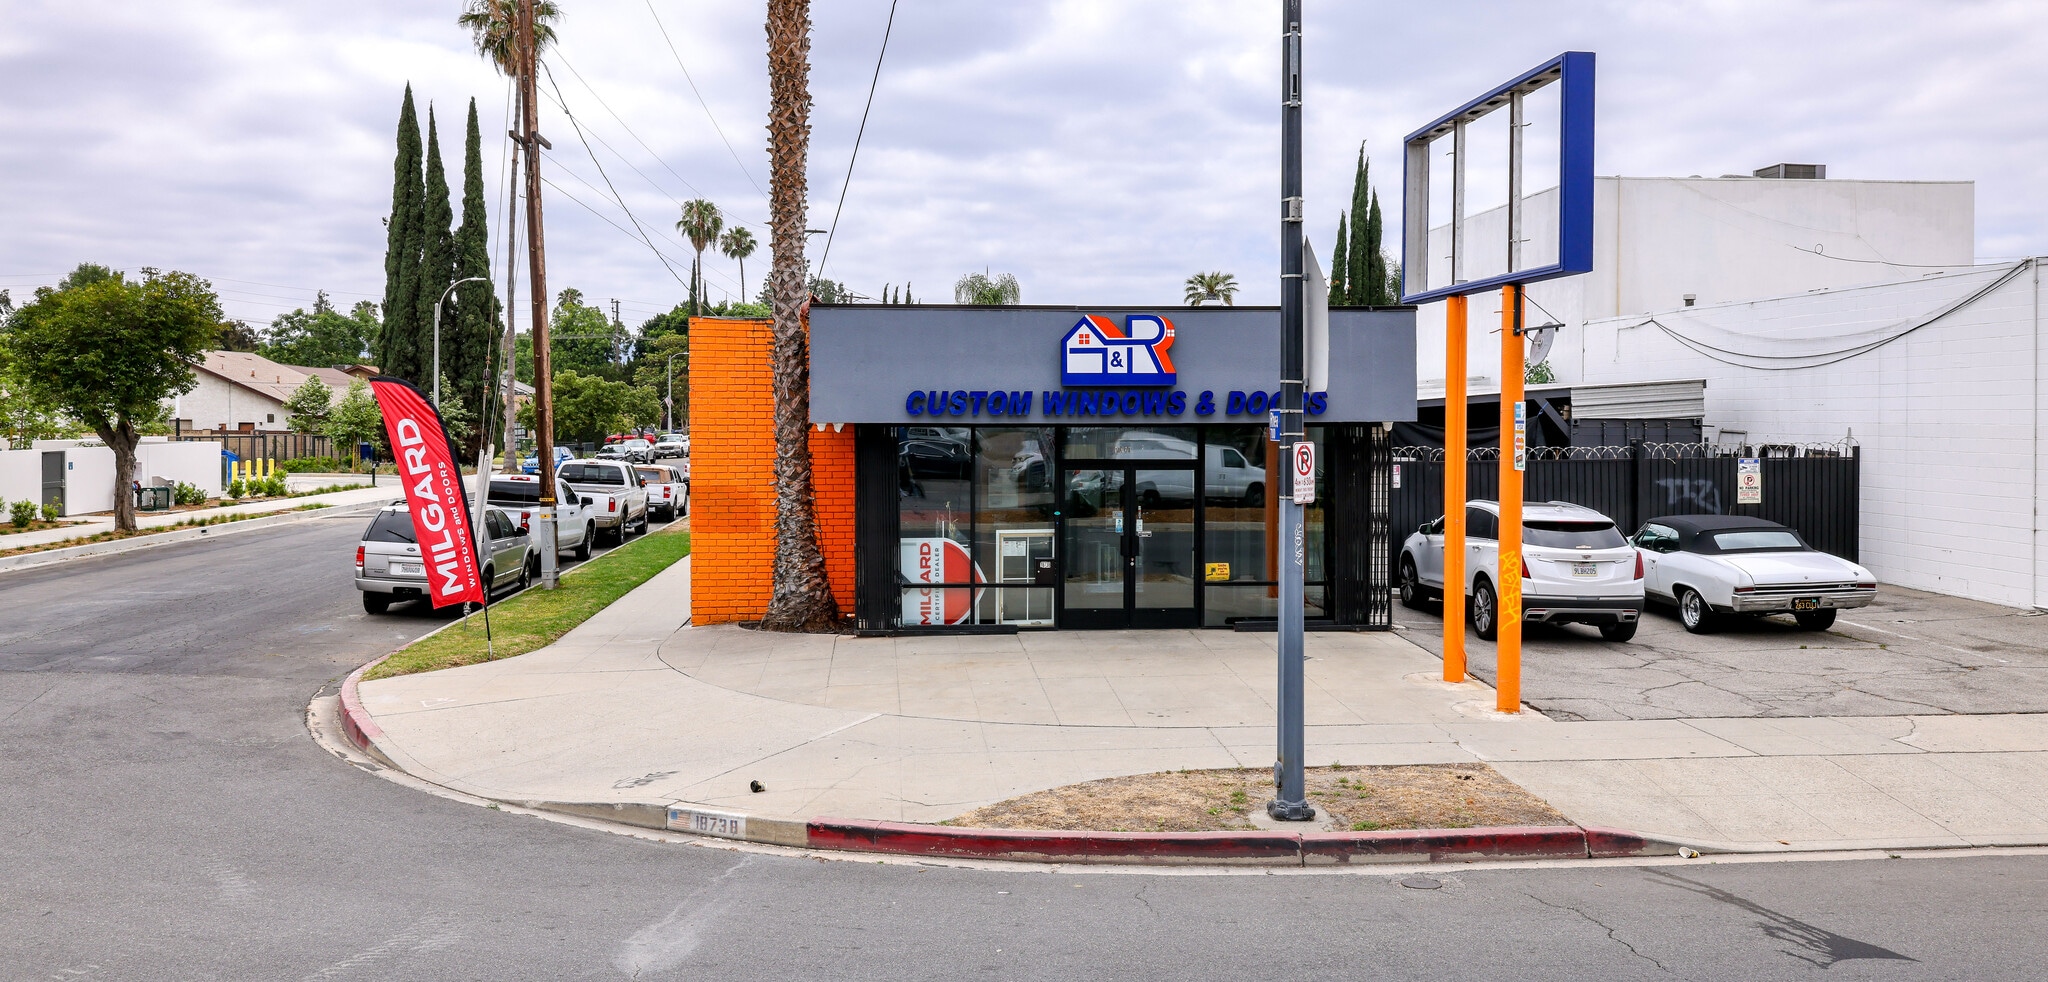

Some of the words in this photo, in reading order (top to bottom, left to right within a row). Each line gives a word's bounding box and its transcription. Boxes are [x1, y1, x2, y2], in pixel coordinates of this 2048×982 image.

[906, 390, 1033, 417] CUSTOM
[1043, 390, 1187, 417] WINDOWS
[1196, 391, 1216, 416] &
[1226, 391, 1329, 416] DOS
[438, 461, 456, 504] DOORS
[397, 417, 465, 597] MILGARD
[450, 507, 462, 525] and
[457, 528, 476, 588] WINDOWS
[696, 815, 738, 836] 18738
